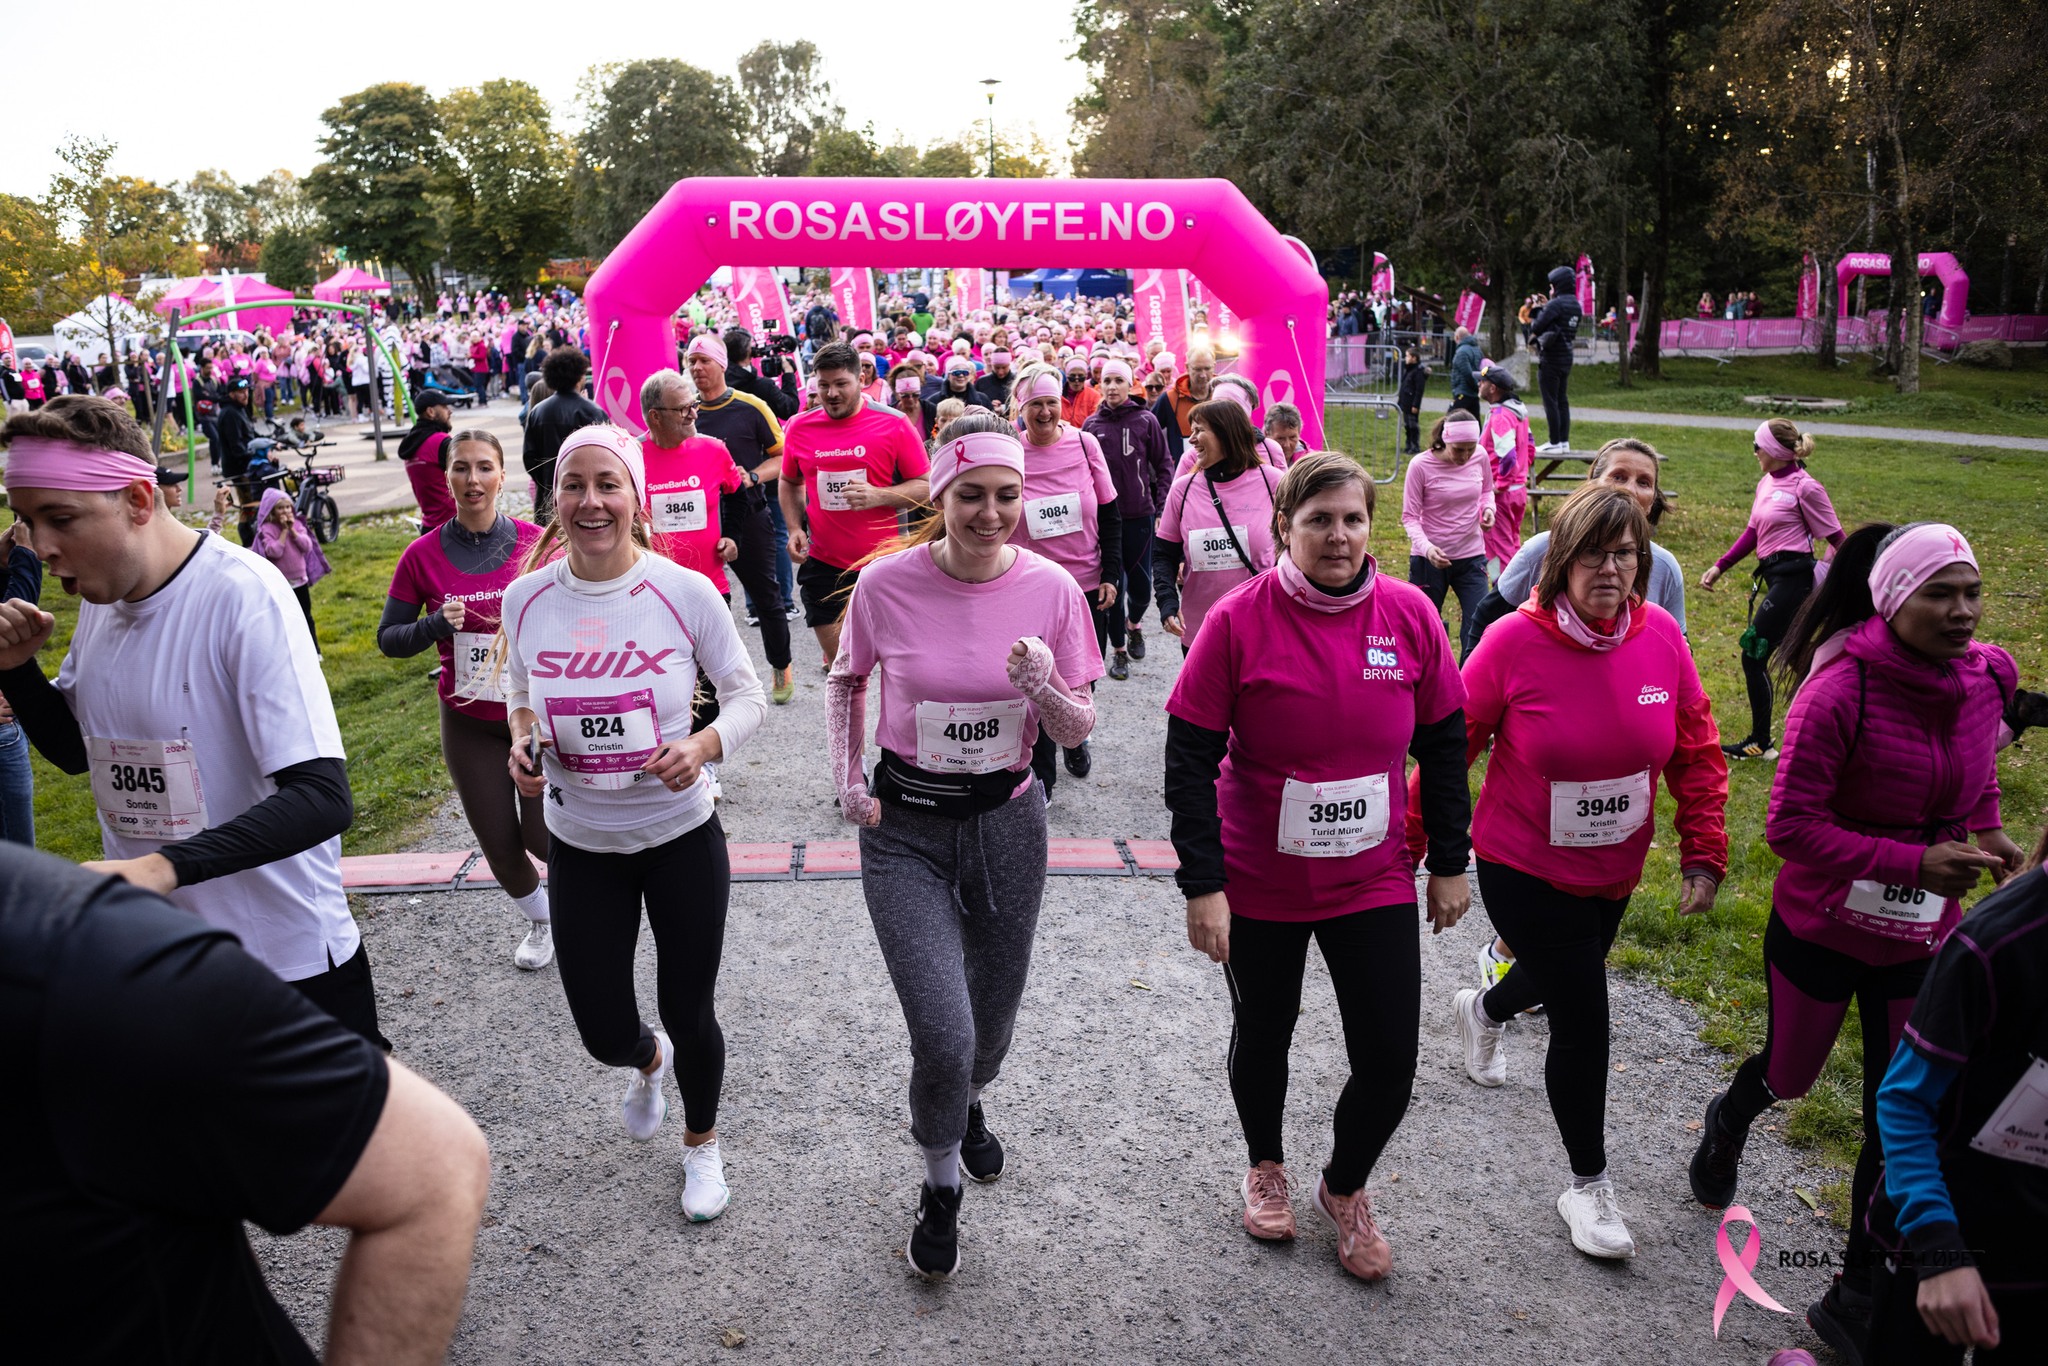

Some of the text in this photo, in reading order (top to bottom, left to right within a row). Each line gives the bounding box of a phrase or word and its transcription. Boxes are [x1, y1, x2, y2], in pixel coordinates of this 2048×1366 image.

[728, 200, 1176, 242] ROSASLØYFE.NO
[814, 448, 854, 458] SpareBank
[648, 480, 688, 492] SpareBank
[665, 501, 694, 514] 3846
[1039, 505, 1068, 519] 3084
[1203, 539, 1234, 552] 3085
[1366, 636, 1396, 646] TEAM
[1363, 669, 1404, 680] BRYNE
[1637, 691, 1669, 705] coop
[580, 717, 625, 738] 824
[944, 718, 999, 742] 4088
[165, 745, 187, 754] 2024
[588, 742, 623, 752] Christin
[961, 747, 984, 755] Stine
[990, 753, 1010, 762] Scandic
[111, 764, 166, 793] 3845
[126, 799, 158, 810] Sondre
[1576, 795, 1629, 817] 3946
[1309, 799, 1366, 823] 3950
[120, 816, 138, 825] coop
[163, 818, 190, 826] Scandic
[1590, 819, 1617, 828] Kristin
[1312, 826, 1363, 836] Turid Mürer
[1879, 906, 1920, 919] Suwanna
[1868, 918, 1888, 927] coop
[2004, 1125, 2039, 1139] Alma
